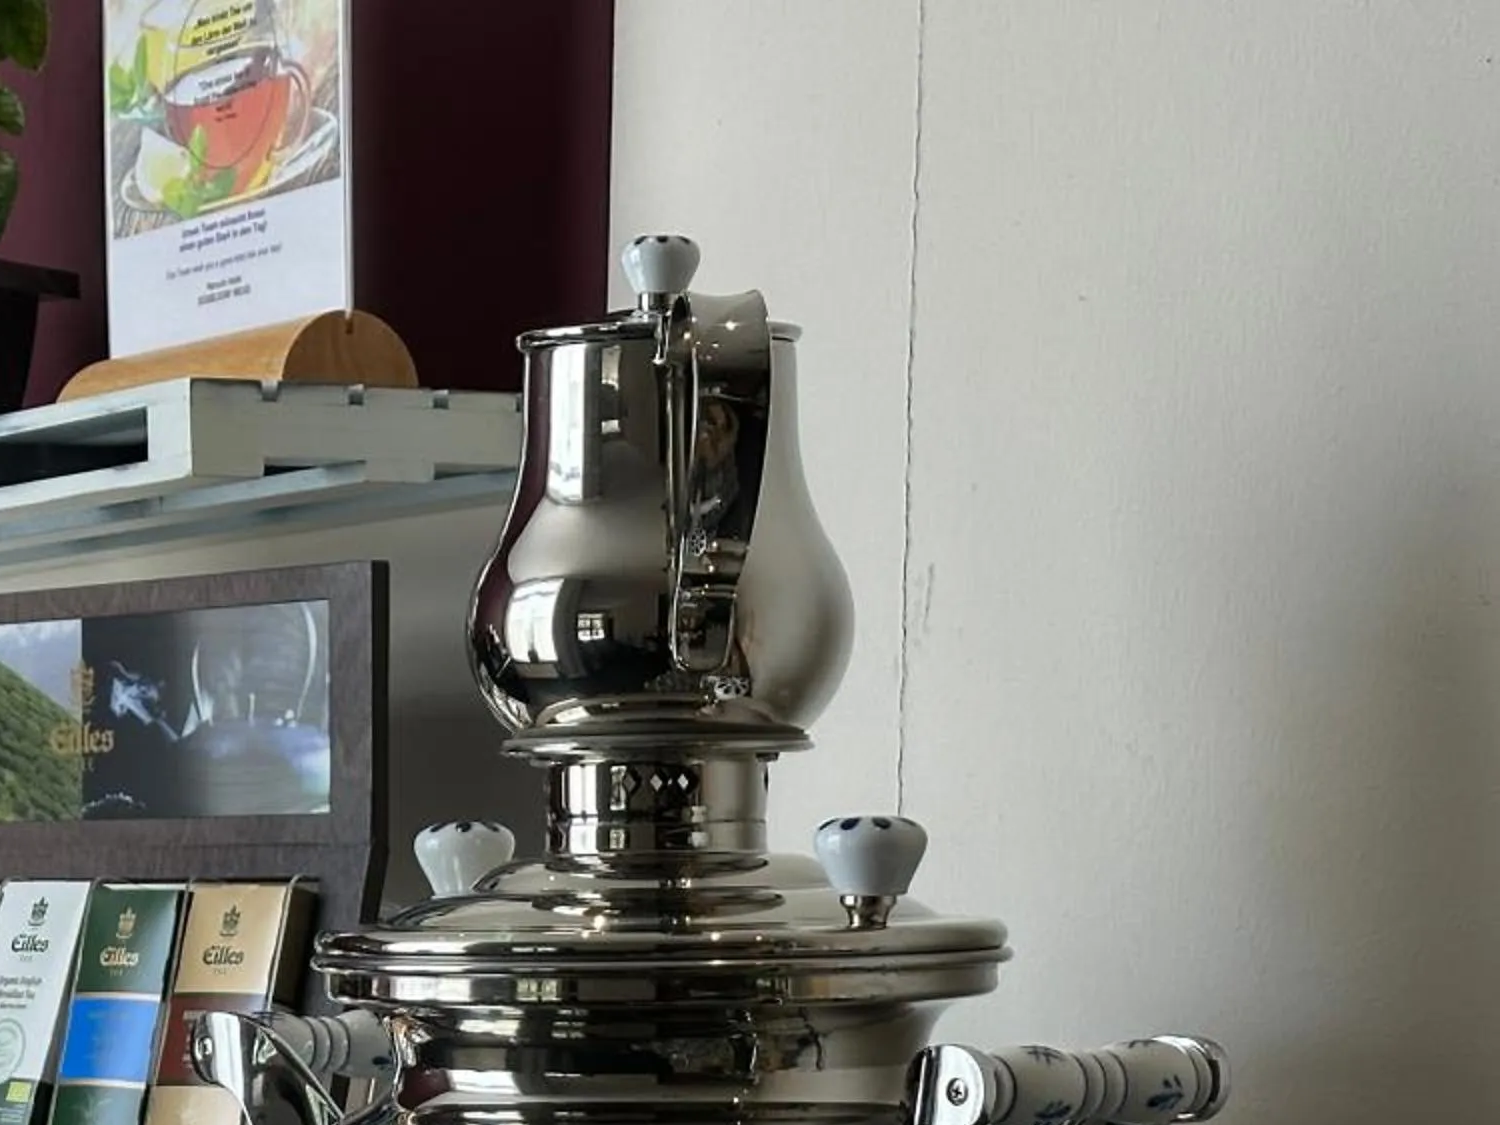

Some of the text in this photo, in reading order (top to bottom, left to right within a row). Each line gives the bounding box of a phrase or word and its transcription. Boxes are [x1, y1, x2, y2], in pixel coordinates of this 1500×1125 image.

[11, 932, 49, 953] Eilles
[100, 946, 140, 966] Eilles
[202, 945, 244, 965] Eilles
